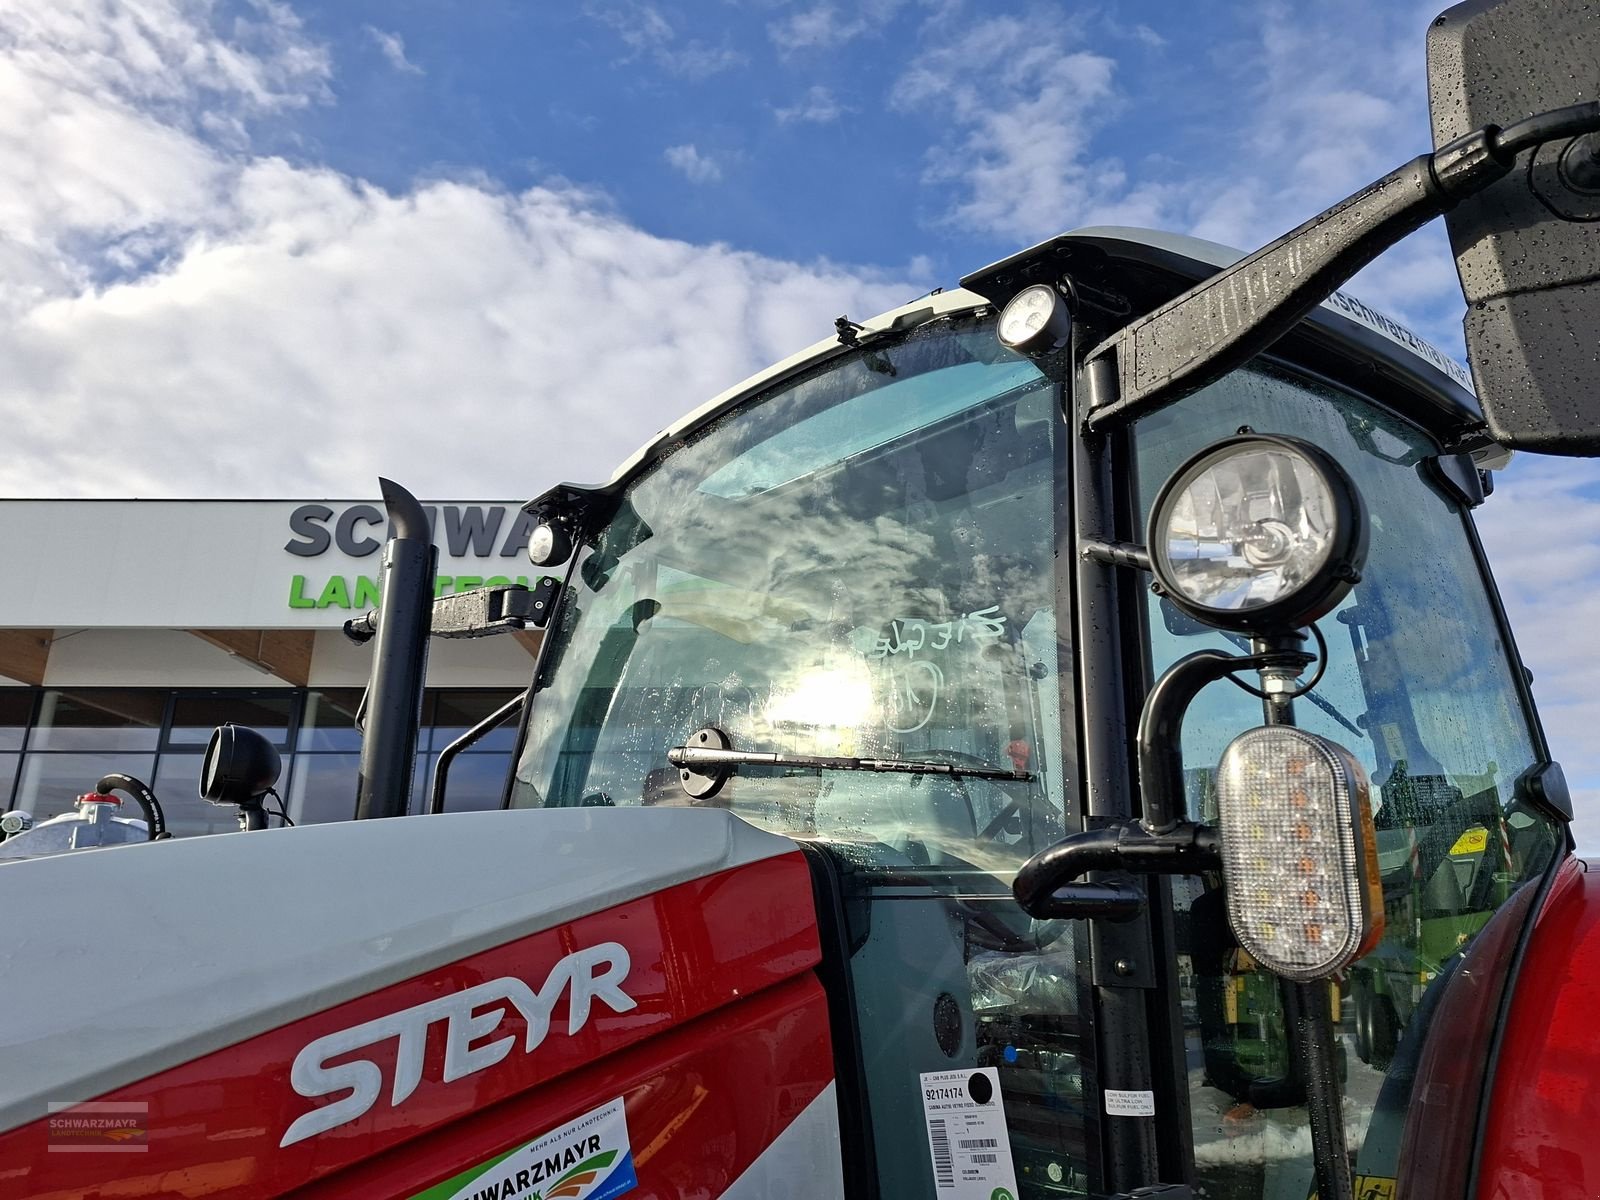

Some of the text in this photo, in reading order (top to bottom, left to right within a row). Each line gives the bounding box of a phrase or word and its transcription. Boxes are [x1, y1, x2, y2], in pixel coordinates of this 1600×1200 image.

[279, 941, 637, 1148] STEYR
[925, 1087, 963, 1100] 92174174
[530, 1141, 548, 1153] MEHR
[550, 1134, 562, 1144] ALS
[563, 1127, 576, 1137] NUR
